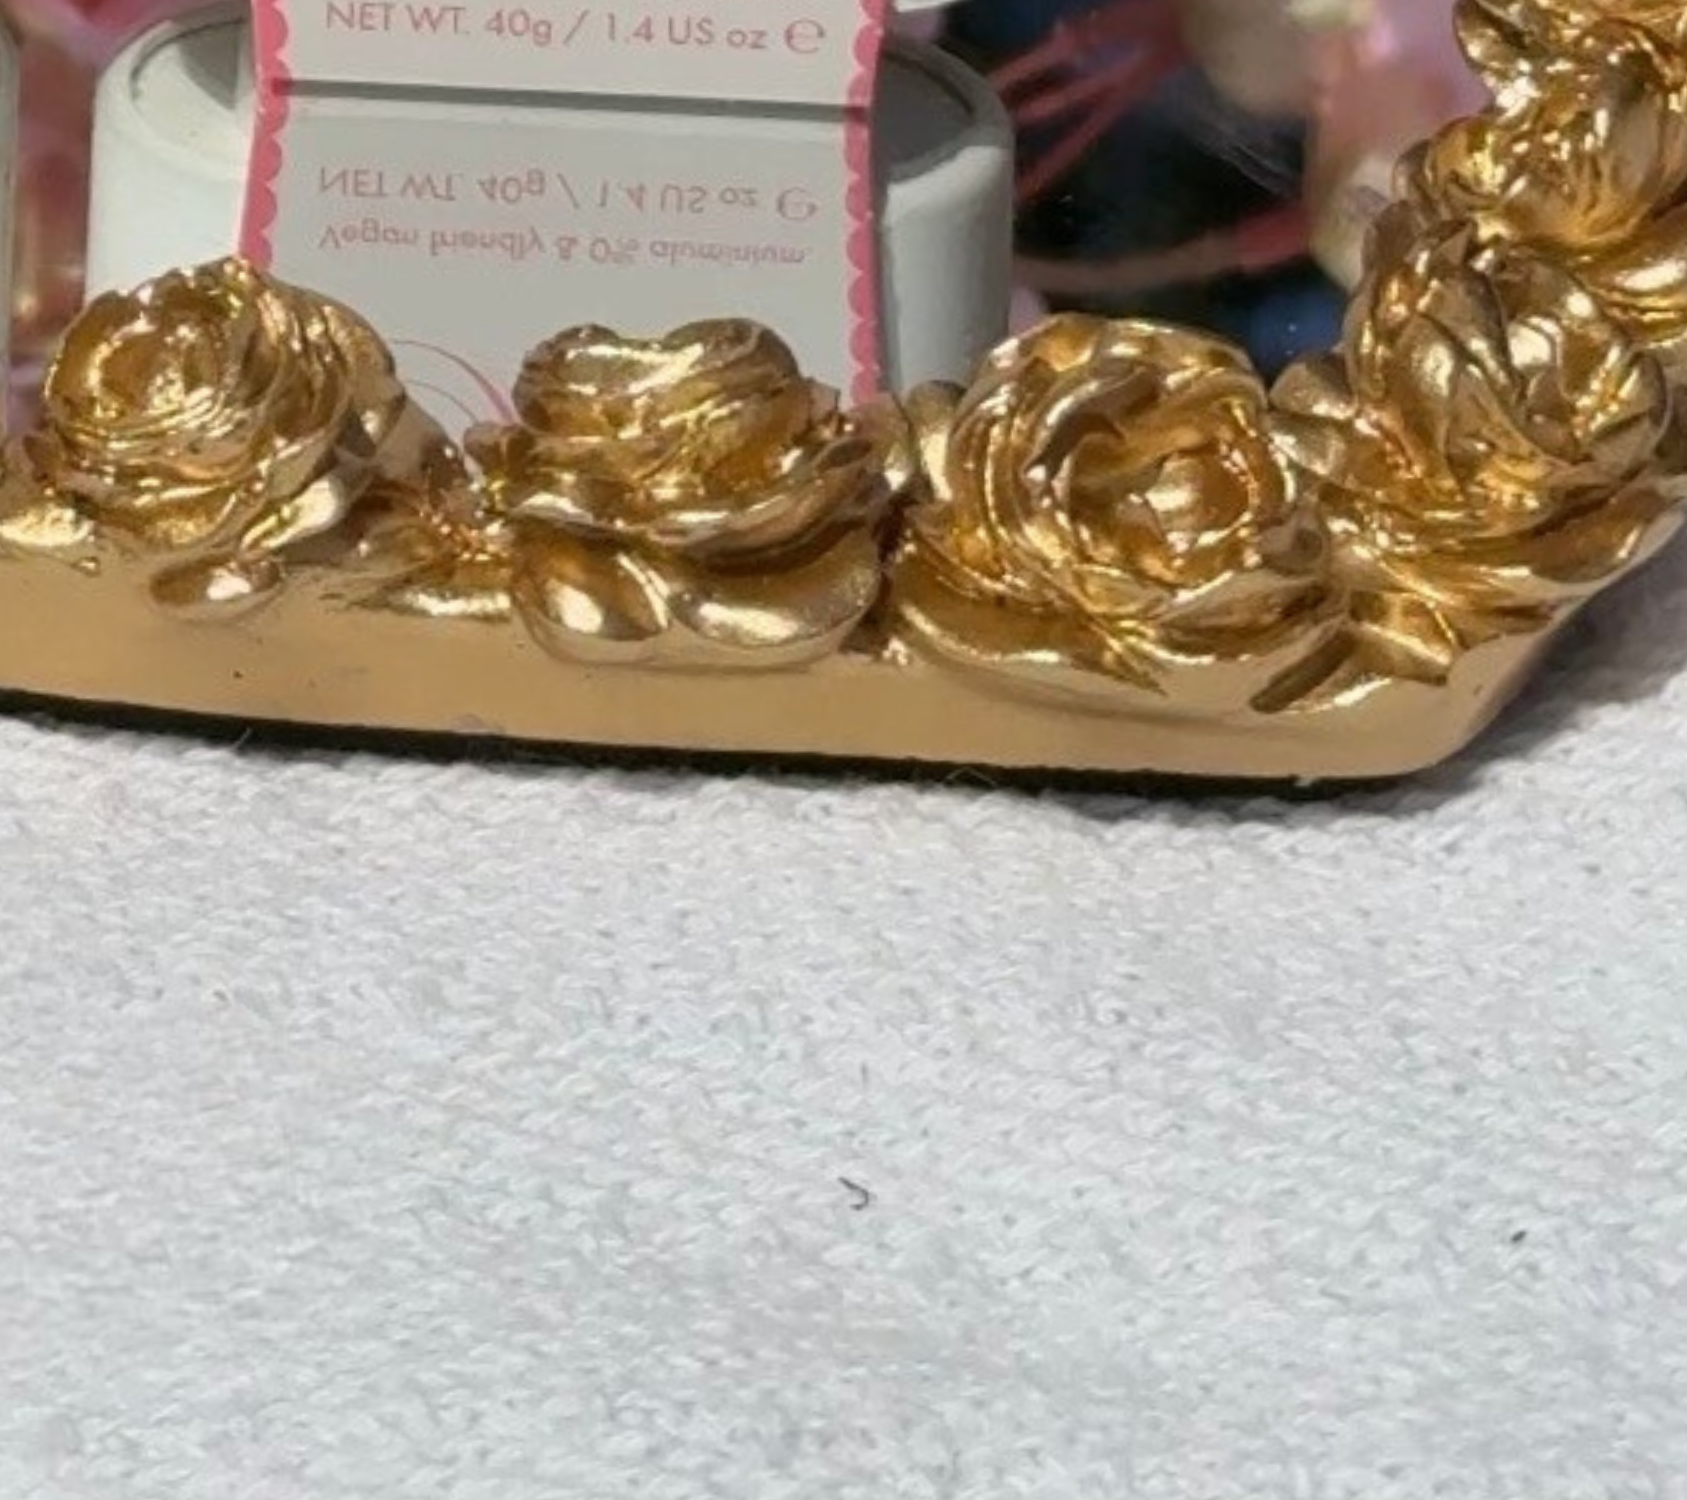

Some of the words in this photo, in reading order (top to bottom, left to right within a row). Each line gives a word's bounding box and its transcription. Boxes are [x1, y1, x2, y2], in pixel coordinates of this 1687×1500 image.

[326, 2, 396, 32] NET
[405, 5, 470, 35] WT.
[484, 8, 553, 48] 40g
[563, 9, 590, 45] /
[607, 12, 654, 44] 1.4
[667, 16, 714, 46] US
[726, 27, 767, 50] oz
